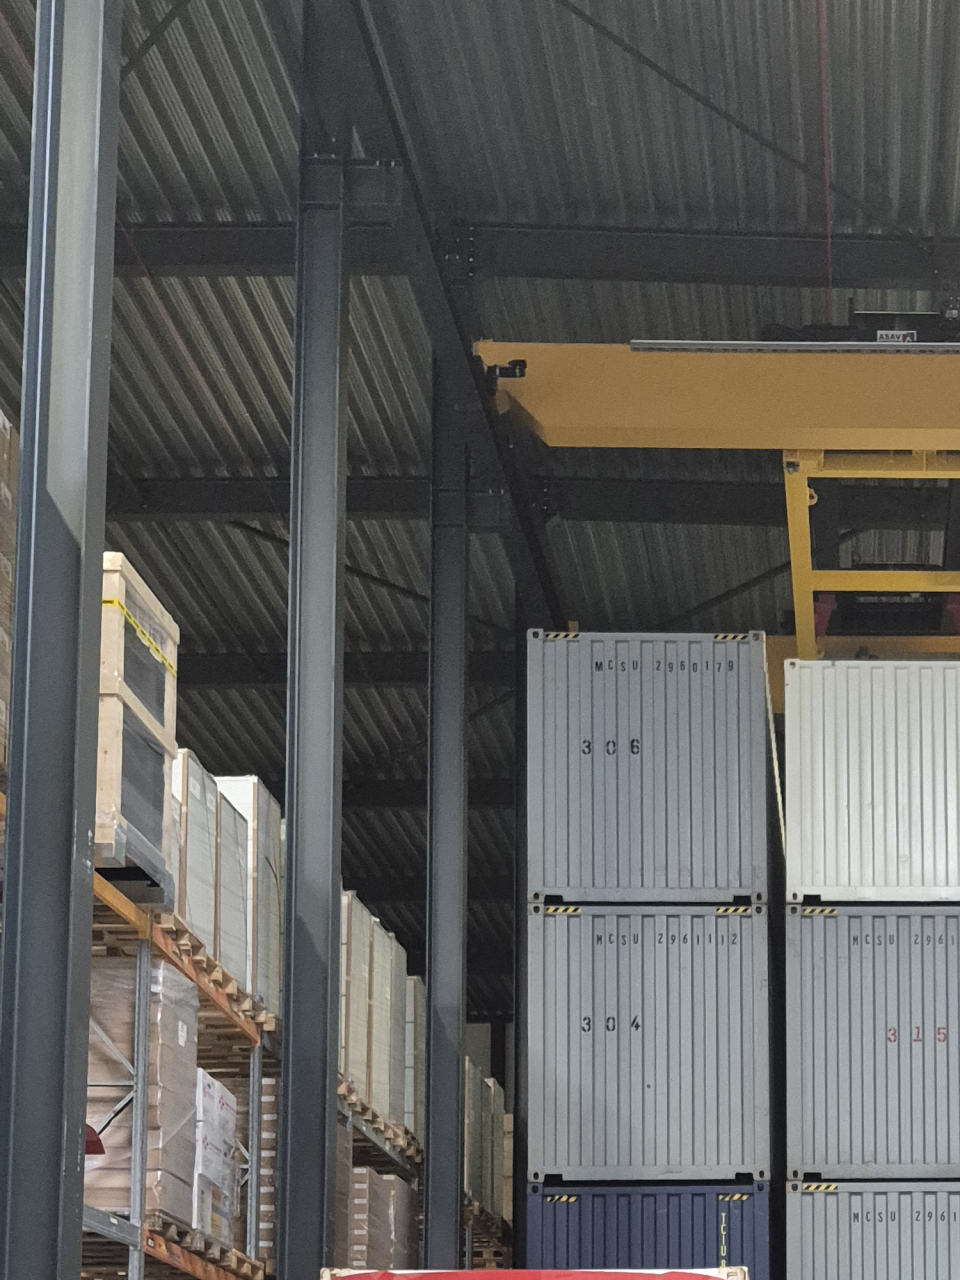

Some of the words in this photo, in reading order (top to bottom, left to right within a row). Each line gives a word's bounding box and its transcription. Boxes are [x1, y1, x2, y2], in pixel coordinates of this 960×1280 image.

[594, 660, 639, 672] MCSU
[655, 660, 734, 673] 2960179
[596, 932, 639, 946] MCSU
[657, 932, 738, 946] 2961112
[852, 932, 895, 946] MCSU
[852, 1211, 896, 1224] MCSU
